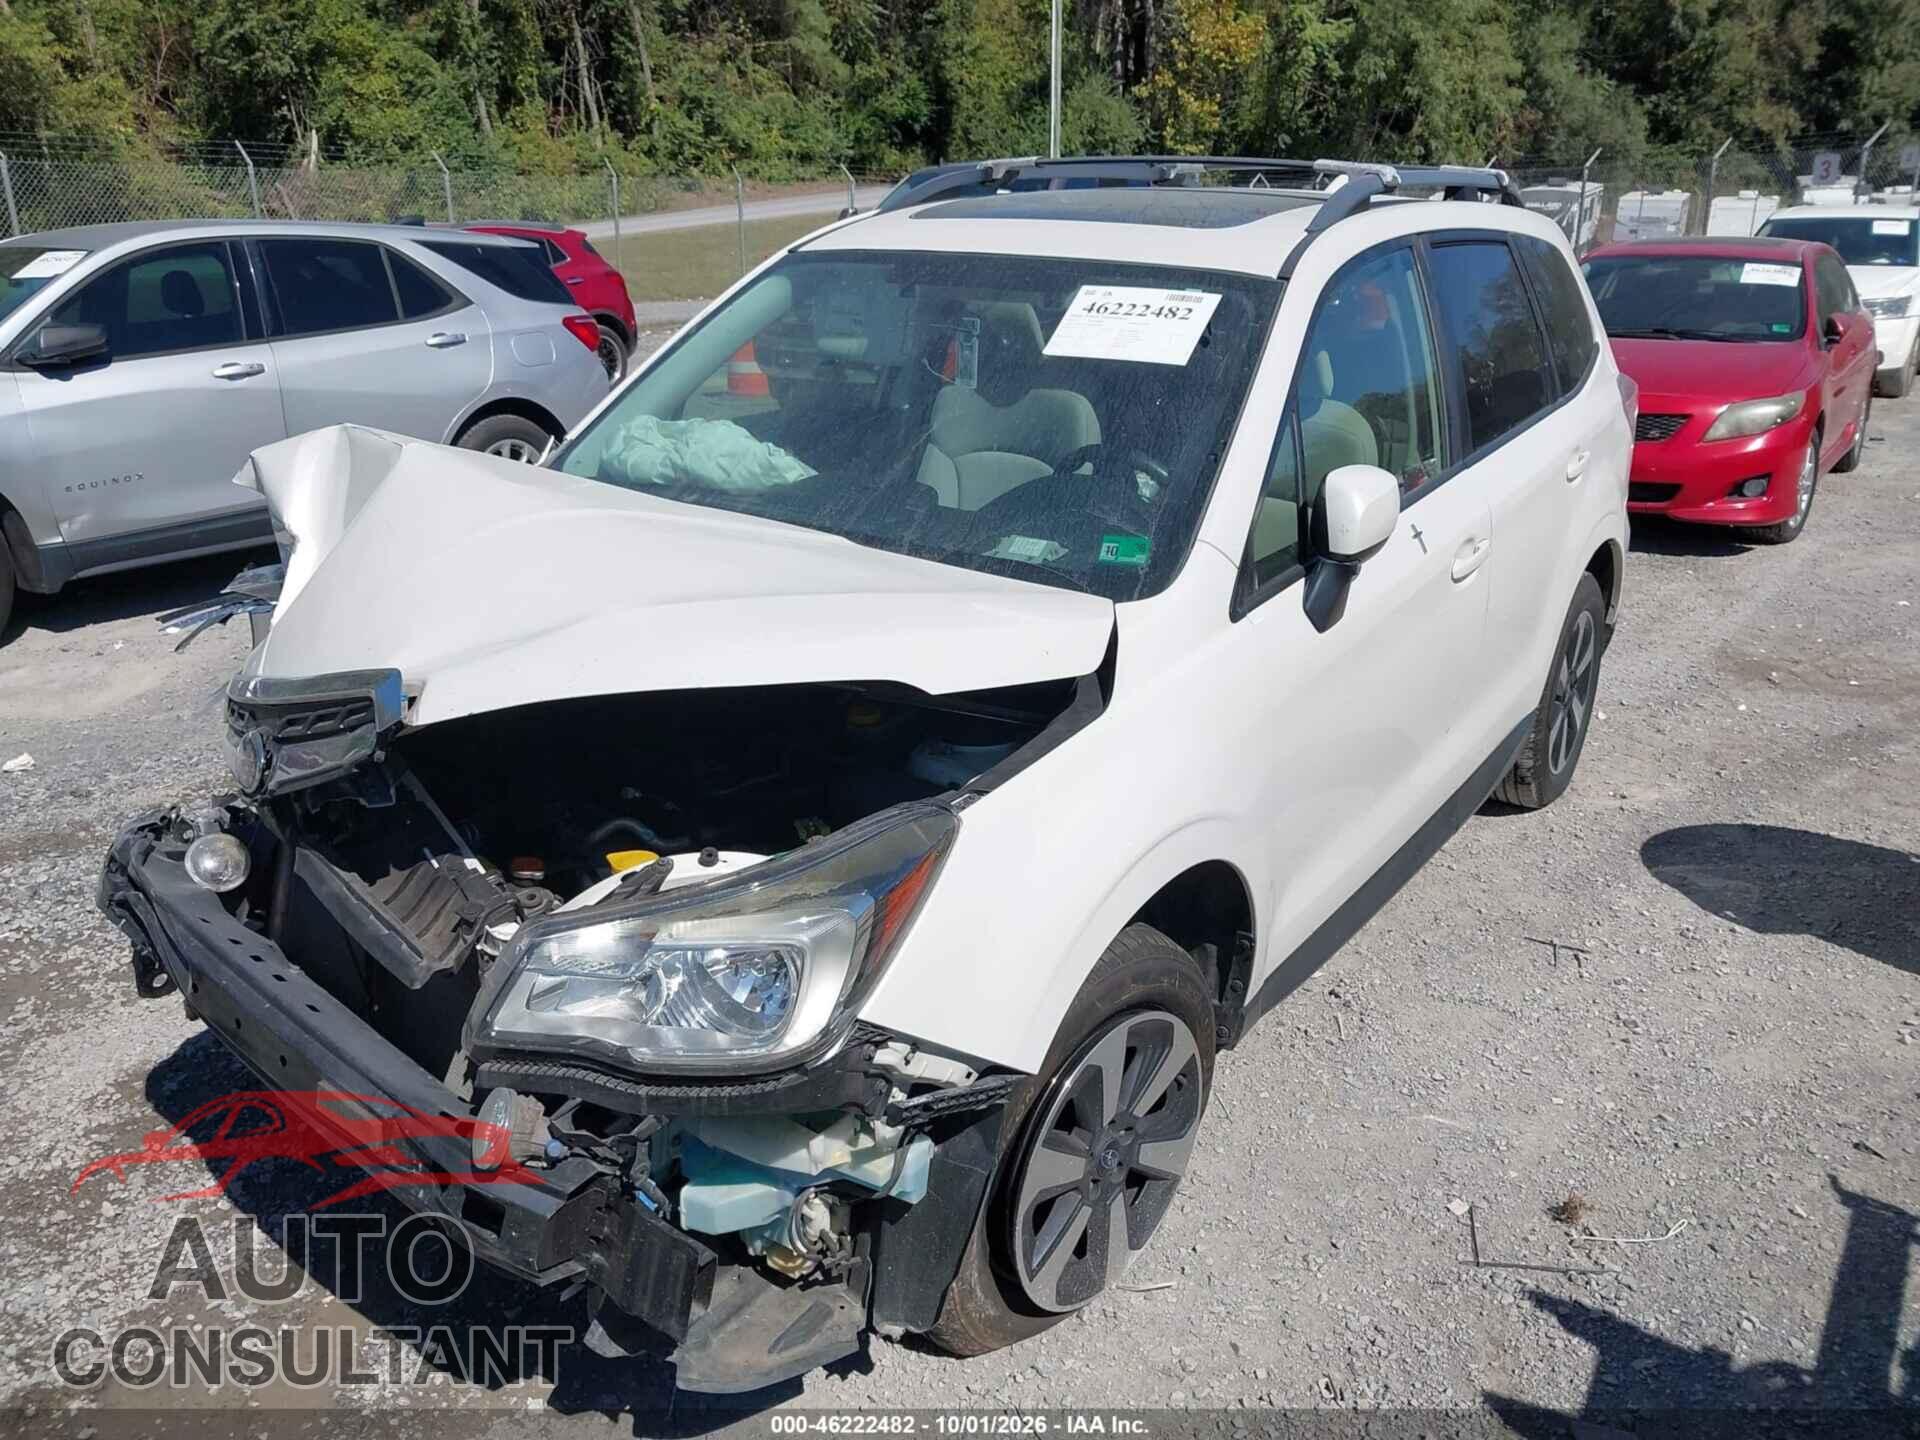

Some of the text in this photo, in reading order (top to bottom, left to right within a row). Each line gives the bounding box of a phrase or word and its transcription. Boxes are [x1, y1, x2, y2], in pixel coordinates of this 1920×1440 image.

[1821, 160, 1831, 180] 3
[1082, 301, 1193, 320] 46222482
[65, 473, 144, 493] EQUINOX
[1105, 544, 1119, 557] 10
